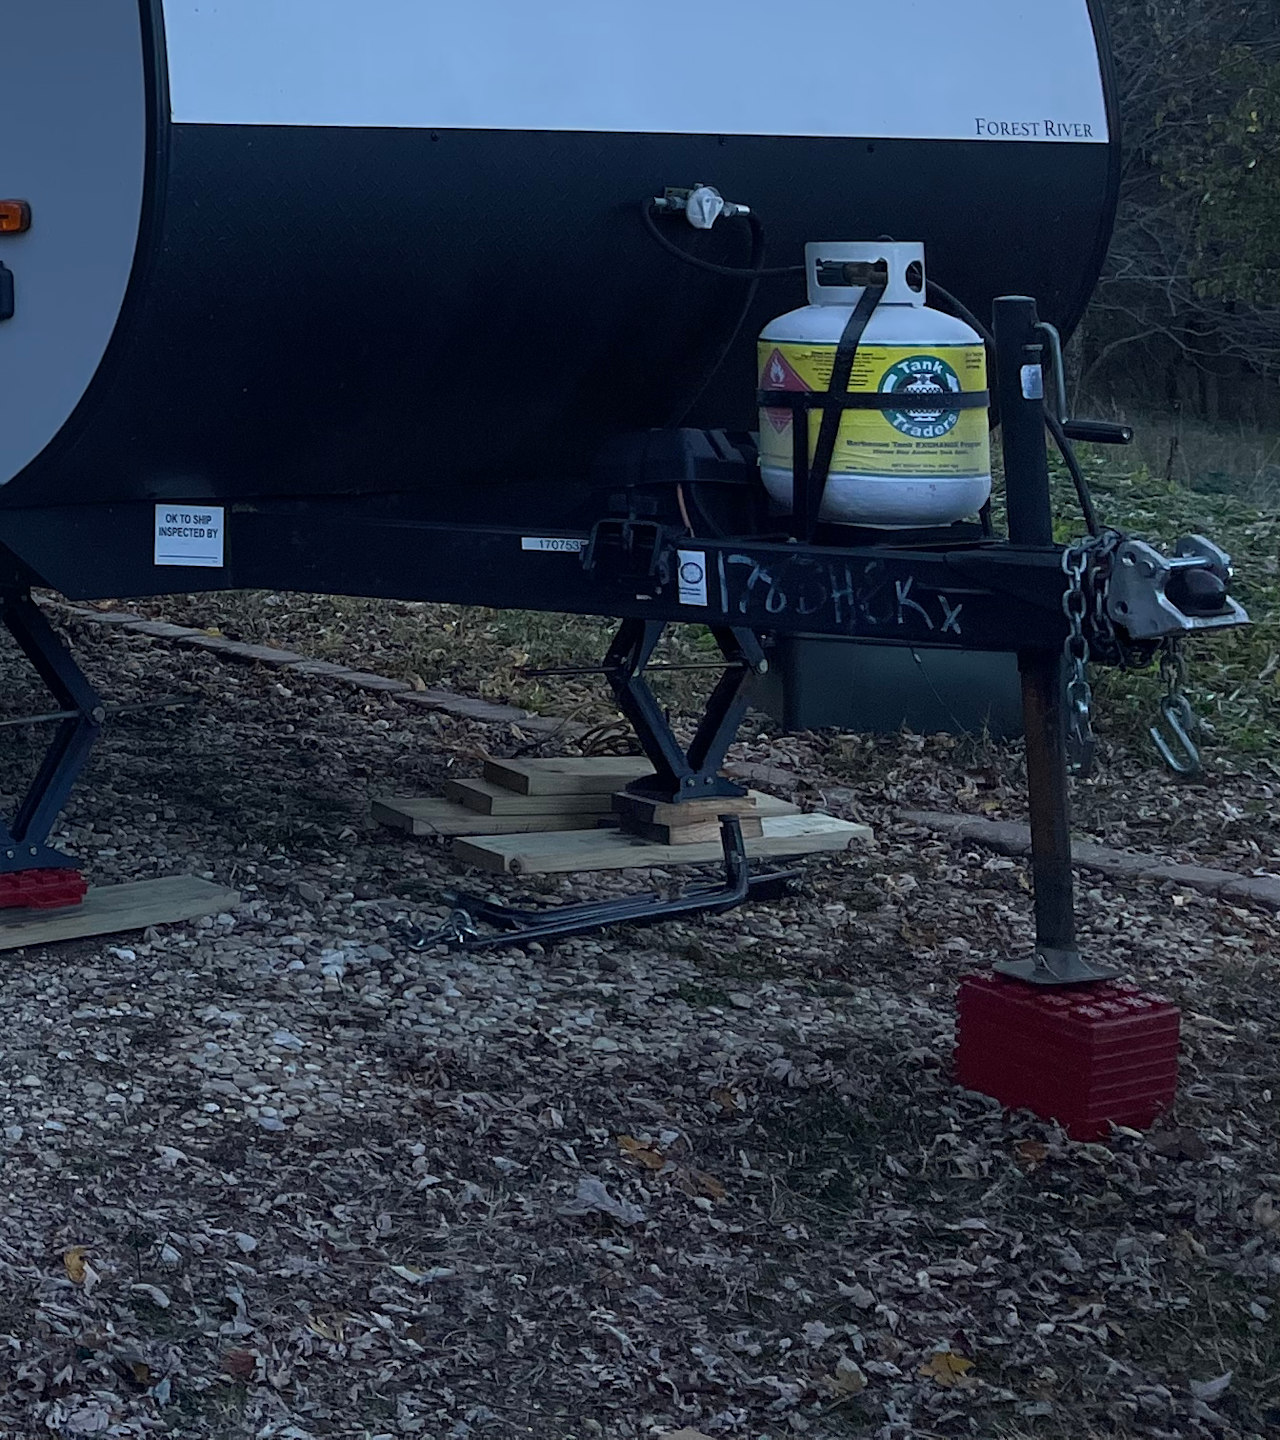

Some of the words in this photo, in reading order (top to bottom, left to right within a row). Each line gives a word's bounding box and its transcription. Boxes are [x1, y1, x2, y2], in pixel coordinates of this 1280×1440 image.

[975, 117, 1040, 136] FOREST
[1043, 119, 1094, 137] RIVER
[897, 360, 943, 374] Tank
[893, 412, 957, 437] Traders
[165, 513, 178, 524] OK
[180, 514, 191, 524] TO
[193, 514, 212, 525] SHIP
[158, 526, 205, 538] INSPECTED
[207, 528, 218, 539] BY
[539, 539, 585, 551] 170753
